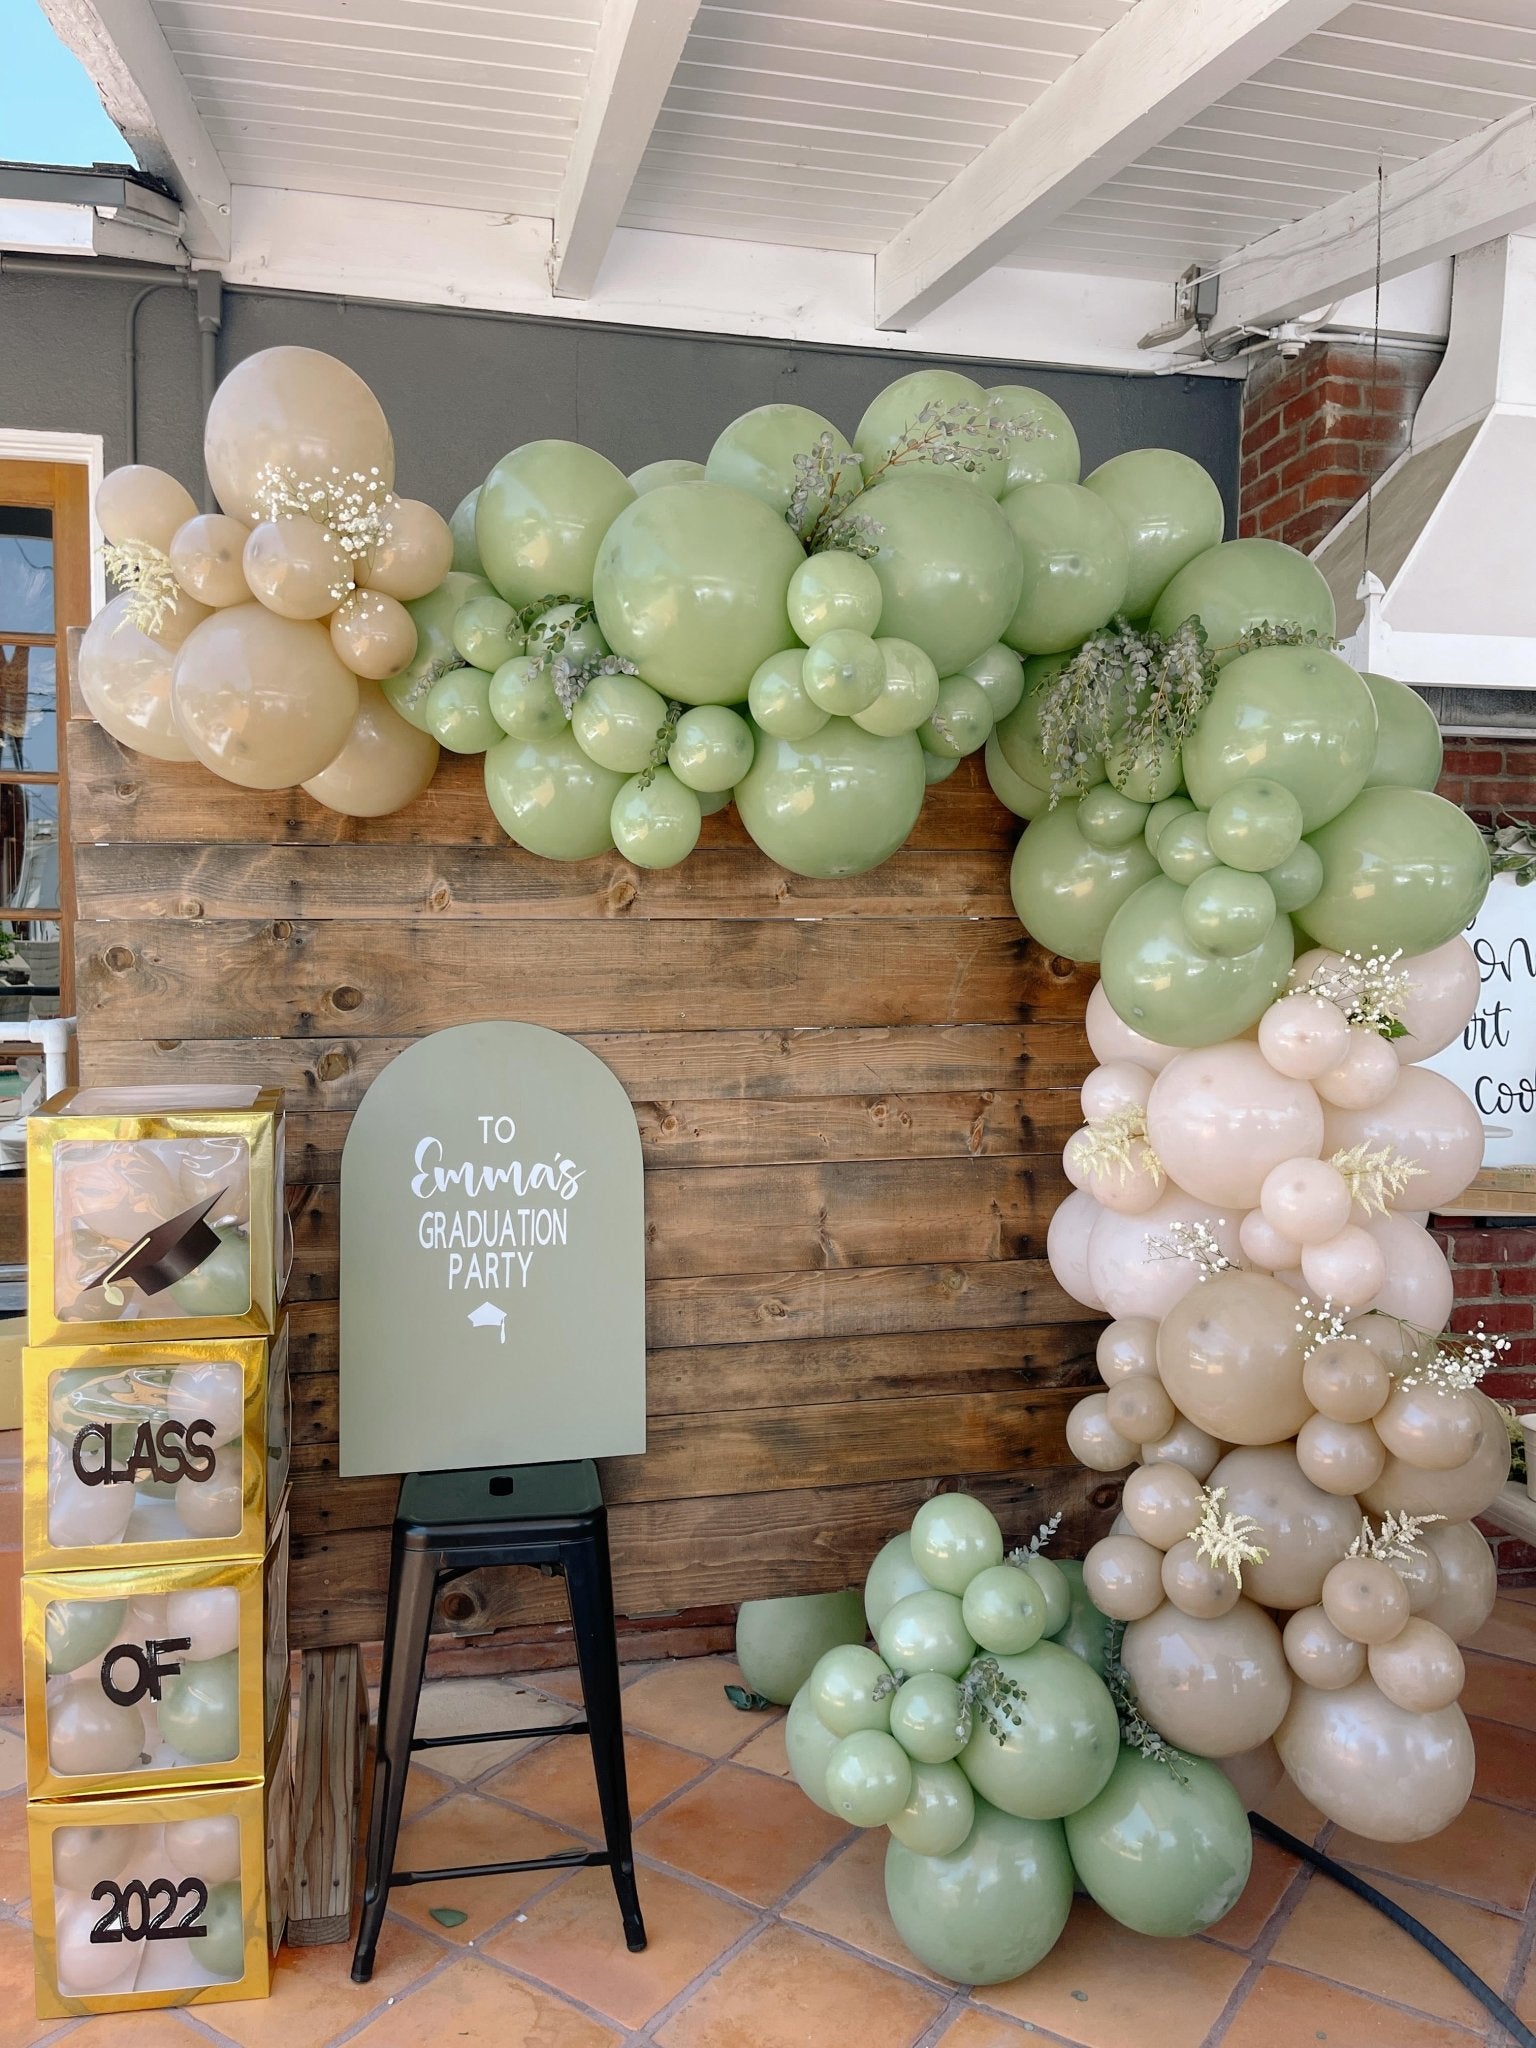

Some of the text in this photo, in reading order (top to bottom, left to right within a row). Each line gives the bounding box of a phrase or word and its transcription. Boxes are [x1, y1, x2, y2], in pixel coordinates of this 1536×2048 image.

[477, 1115, 516, 1144] TO
[410, 1135, 587, 1200] Emma's
[418, 1208, 567, 1249] GRADUATION
[448, 1251, 534, 1290] PARTY
[72, 1418, 217, 1487] CLASS
[100, 1636, 192, 1707] OF
[89, 1877, 208, 1944] 2022
